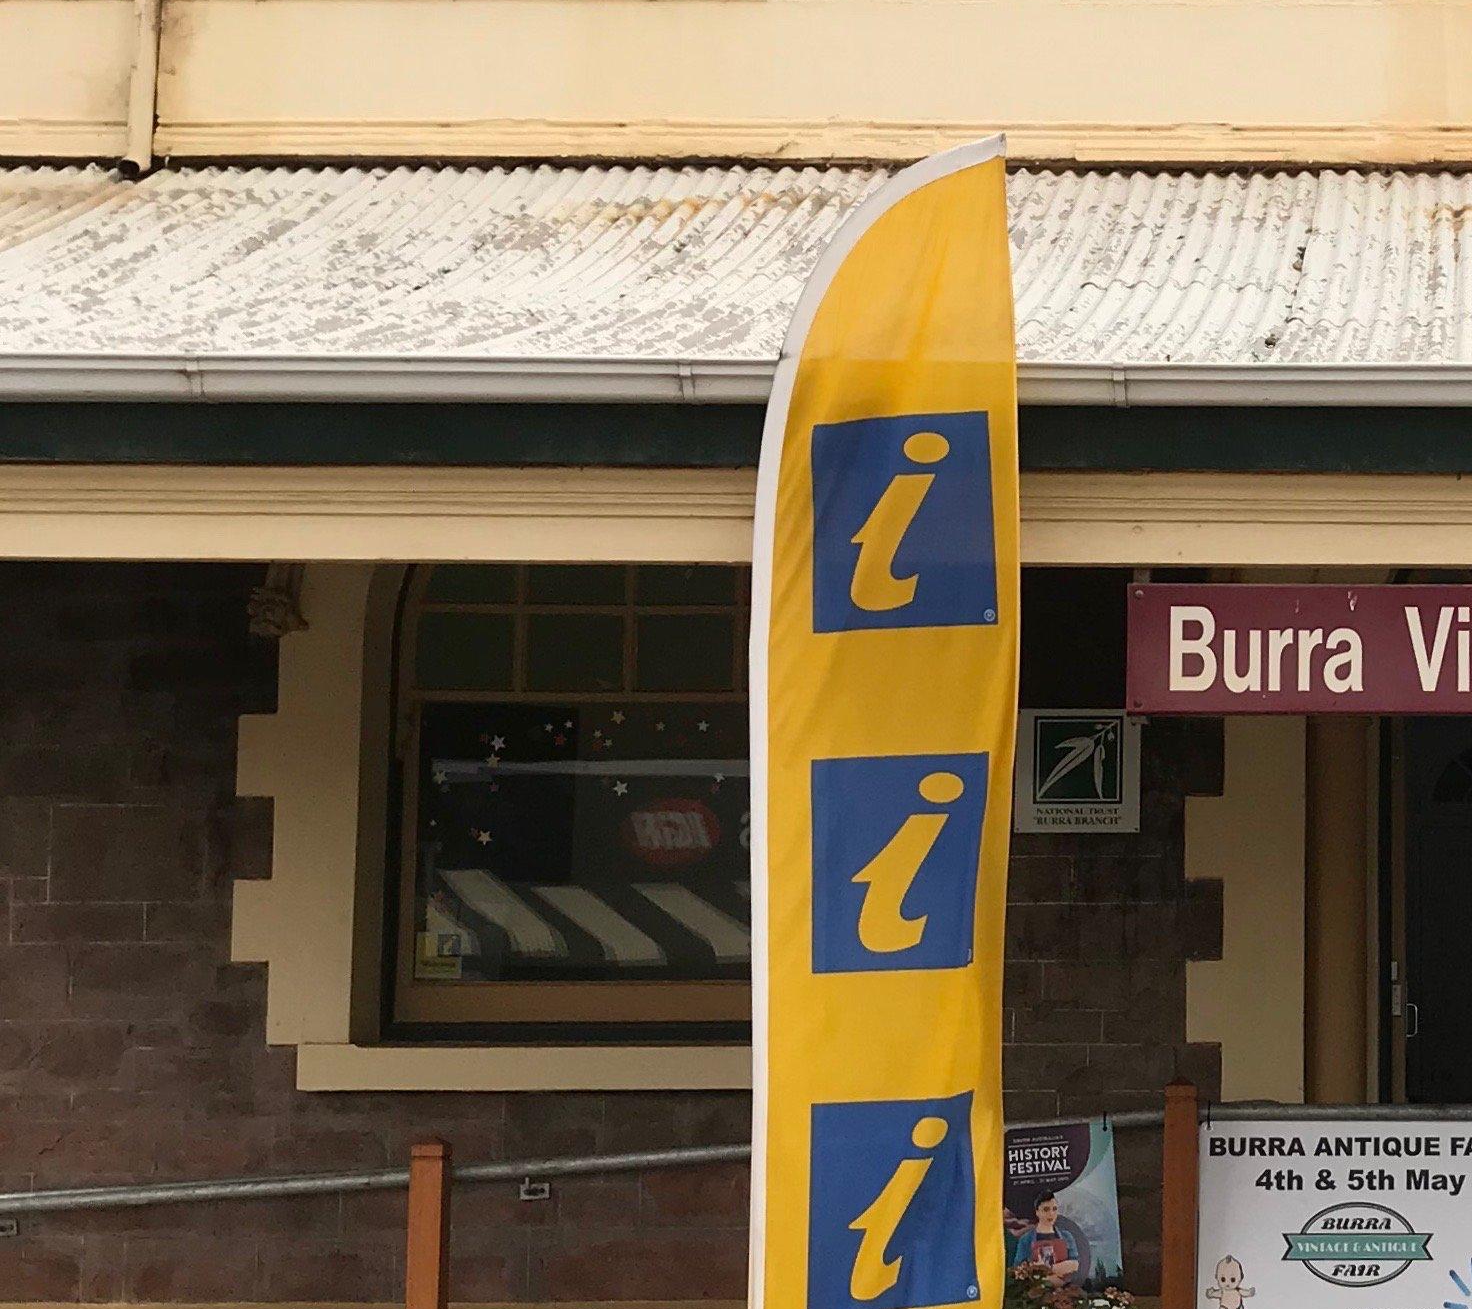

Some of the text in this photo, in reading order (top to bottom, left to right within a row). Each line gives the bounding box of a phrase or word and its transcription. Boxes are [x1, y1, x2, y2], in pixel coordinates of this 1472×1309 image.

[1168, 605, 1363, 693] Burra
[1036, 807, 1119, 815] NATIONAL TRUST
[1008, 1146, 1069, 1162] HISTORY
[1209, 1137, 1305, 1157] BURRA
[1314, 1137, 1440, 1158] ANTIQUE
[1009, 1159, 1071, 1175] FESTIVAL
[1255, 1168, 1466, 1196] 4th & 5th May
[1321, 1217, 1392, 1230] BURRA
[1297, 1242, 1350, 1253] VINTAGE
[1363, 1242, 1418, 1253] ANTIQUE
[1332, 1264, 1381, 1277] FAIR
